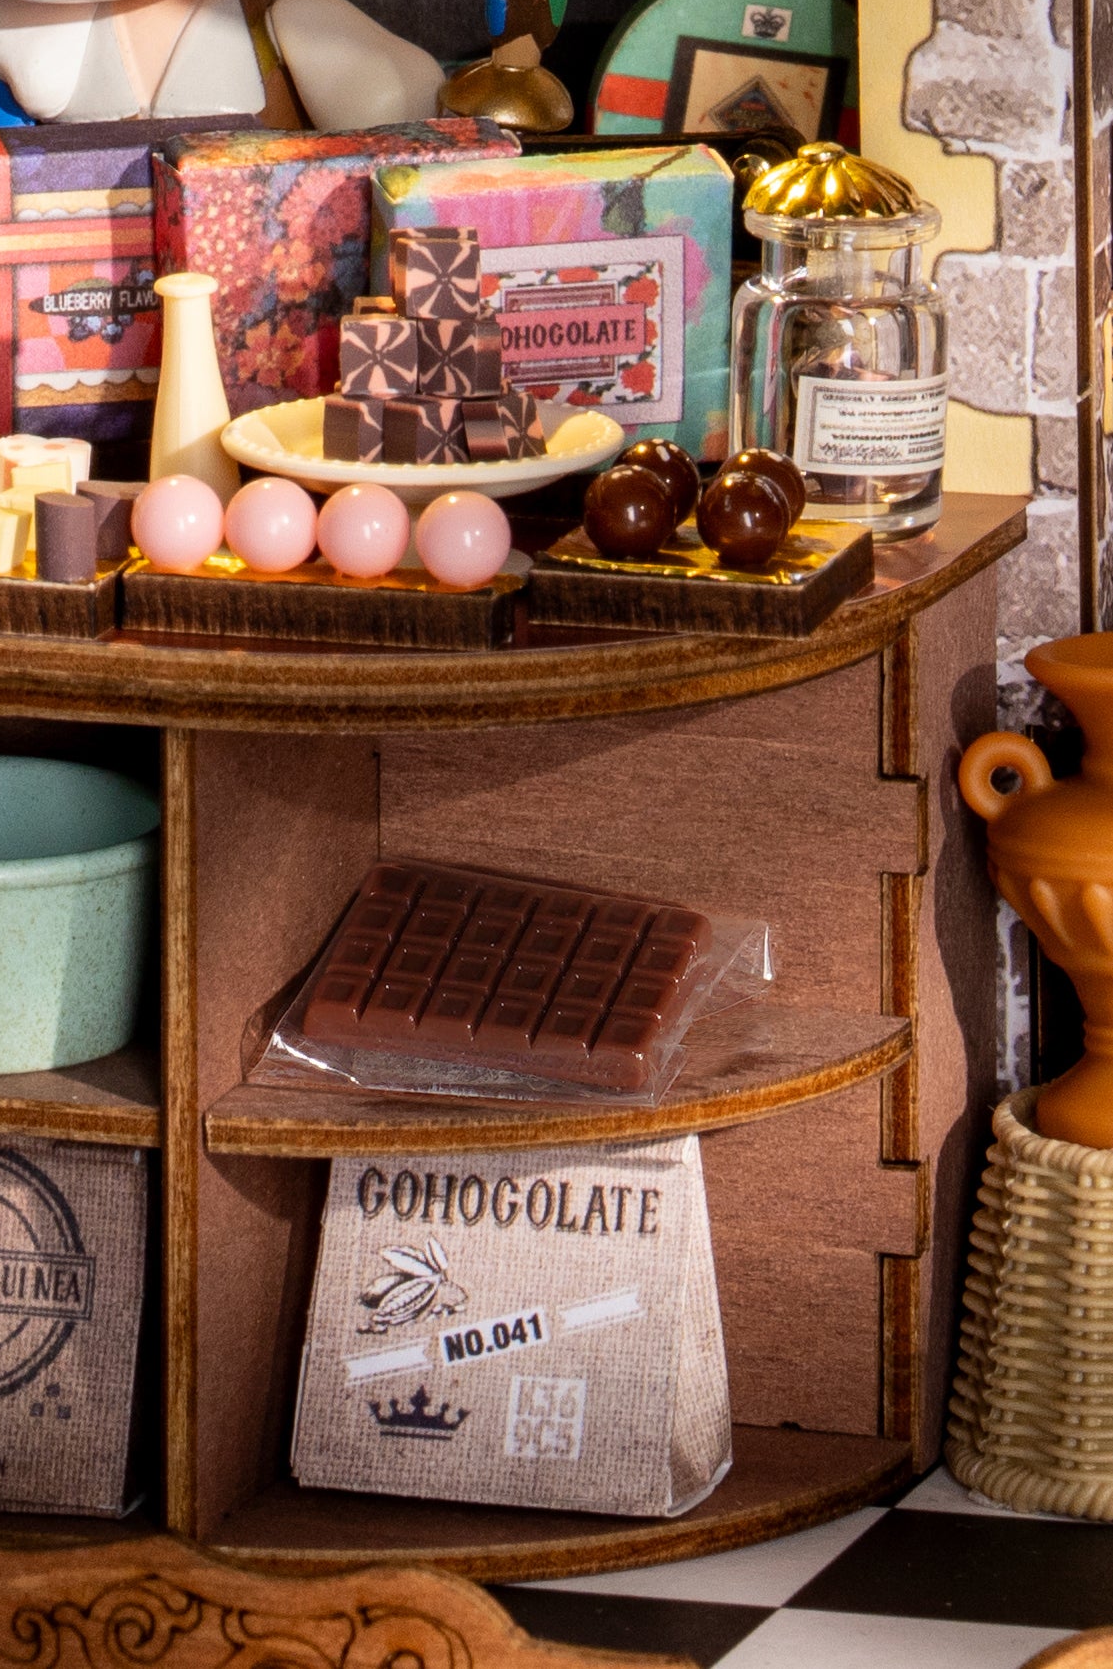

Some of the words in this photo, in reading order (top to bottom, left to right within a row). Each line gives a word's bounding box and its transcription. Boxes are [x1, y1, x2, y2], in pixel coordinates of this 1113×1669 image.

[43, 291, 112, 312] BLUEBERRY
[119, 288, 161, 308] FLAVO
[442, 1313, 543, 1363] NO.041
